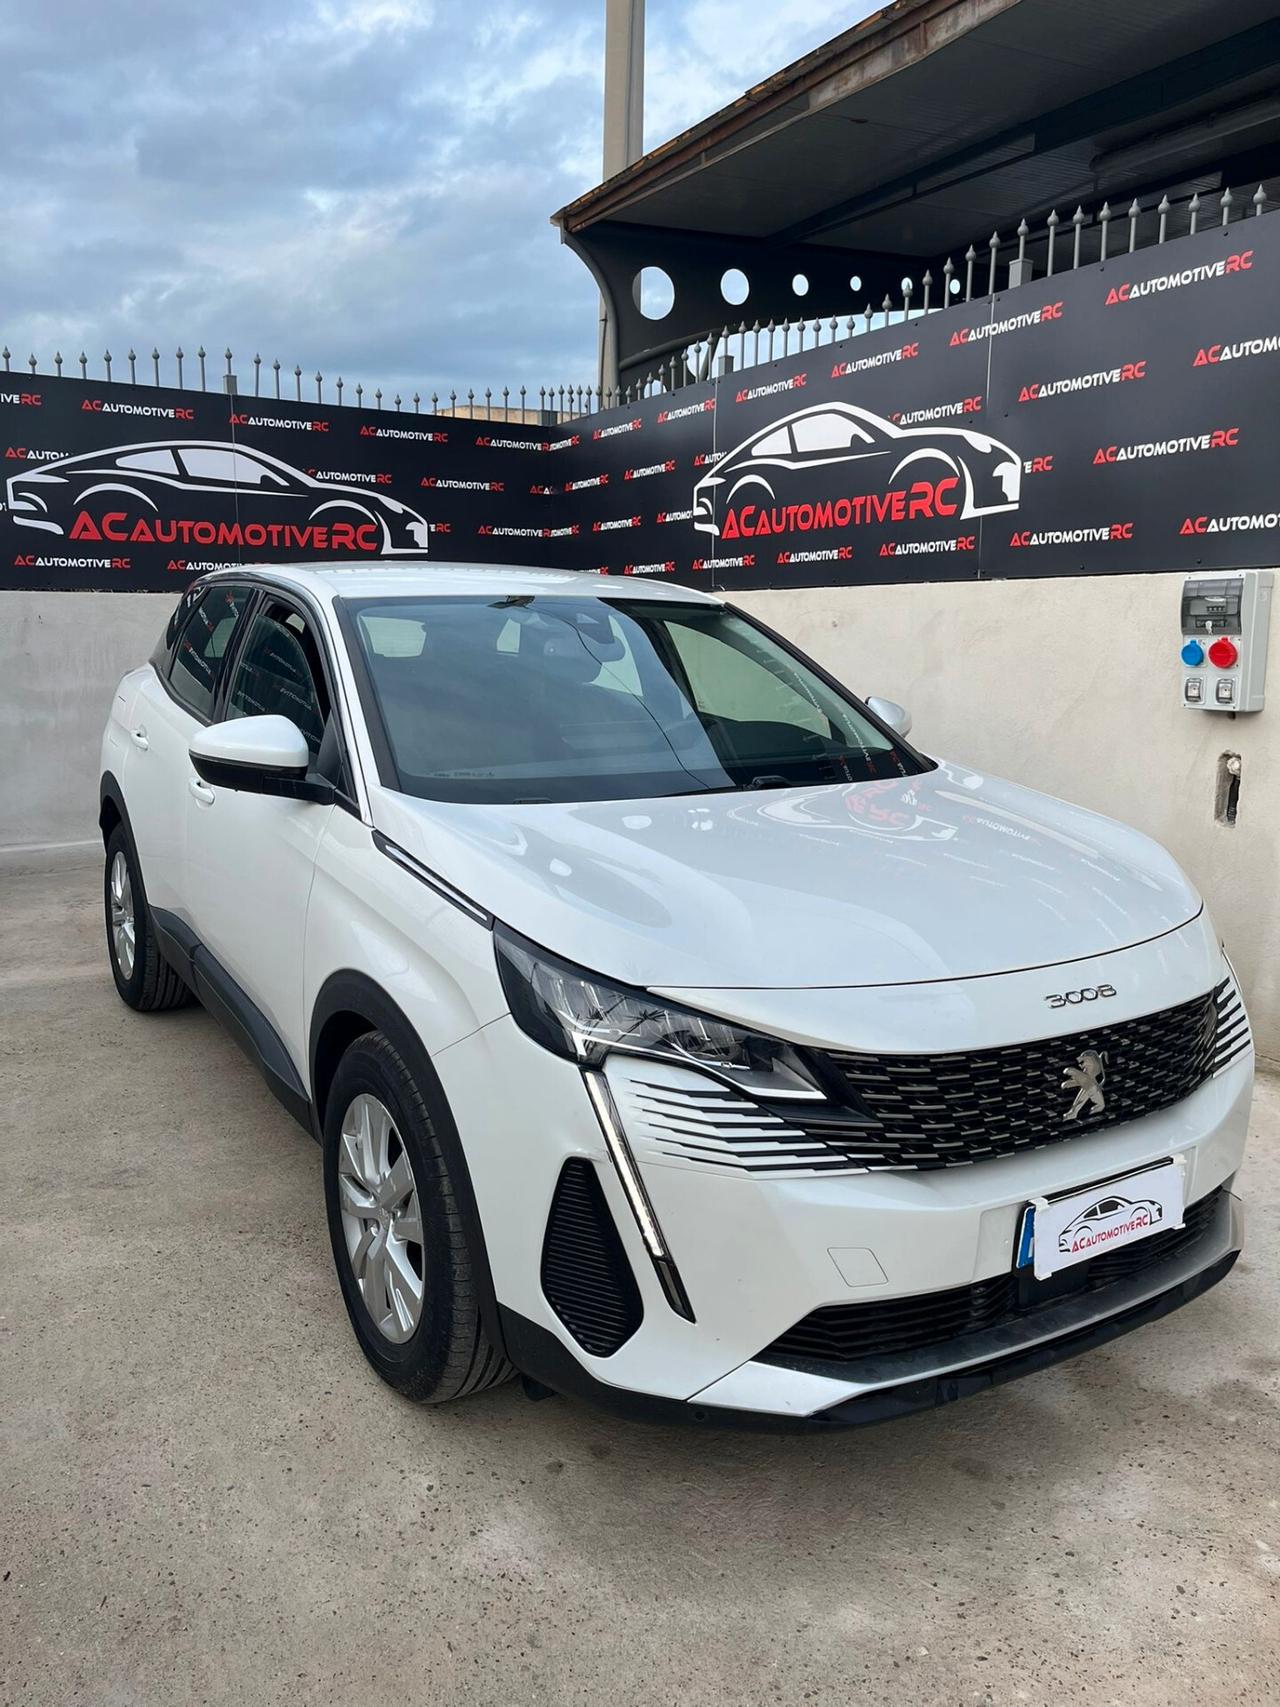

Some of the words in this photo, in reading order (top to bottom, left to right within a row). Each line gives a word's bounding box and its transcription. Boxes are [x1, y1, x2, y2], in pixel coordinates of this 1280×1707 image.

[1105, 250, 1254, 305] ACAUTOMOTIVERC
[950, 301, 1064, 347] ACAUTOMOTIVERC
[831, 343, 919, 378] ACAUTOMOTIVERC
[1193, 336, 1280, 367] ACAUTOM
[1018, 361, 1147, 402] ACAUTOMOTIVERC
[81, 399, 194, 420] ACAUTOMOTIVERC
[229, 414, 330, 432] ACAUTOMOTIVERC
[888, 396, 982, 426] CAUTOMOTIVERC
[1093, 428, 1239, 465] ACAUTOMOTIVERC
[721, 477, 960, 540] ACAUTOMOTIVERC
[69, 510, 378, 551] ACAUTOMOTIVERC
[1009, 523, 1133, 547] ACAUTOMOTIVERC
[1180, 514, 1280, 535] ACAUTOMO
[15, 555, 131, 568] ACAUTOMOTIVERC
[880, 536, 976, 557] ACAUTOMOTIVERC
[1045, 983, 1117, 1009] 3008
[1071, 1213, 1149, 1253] ACAUTOMOTIVERC
